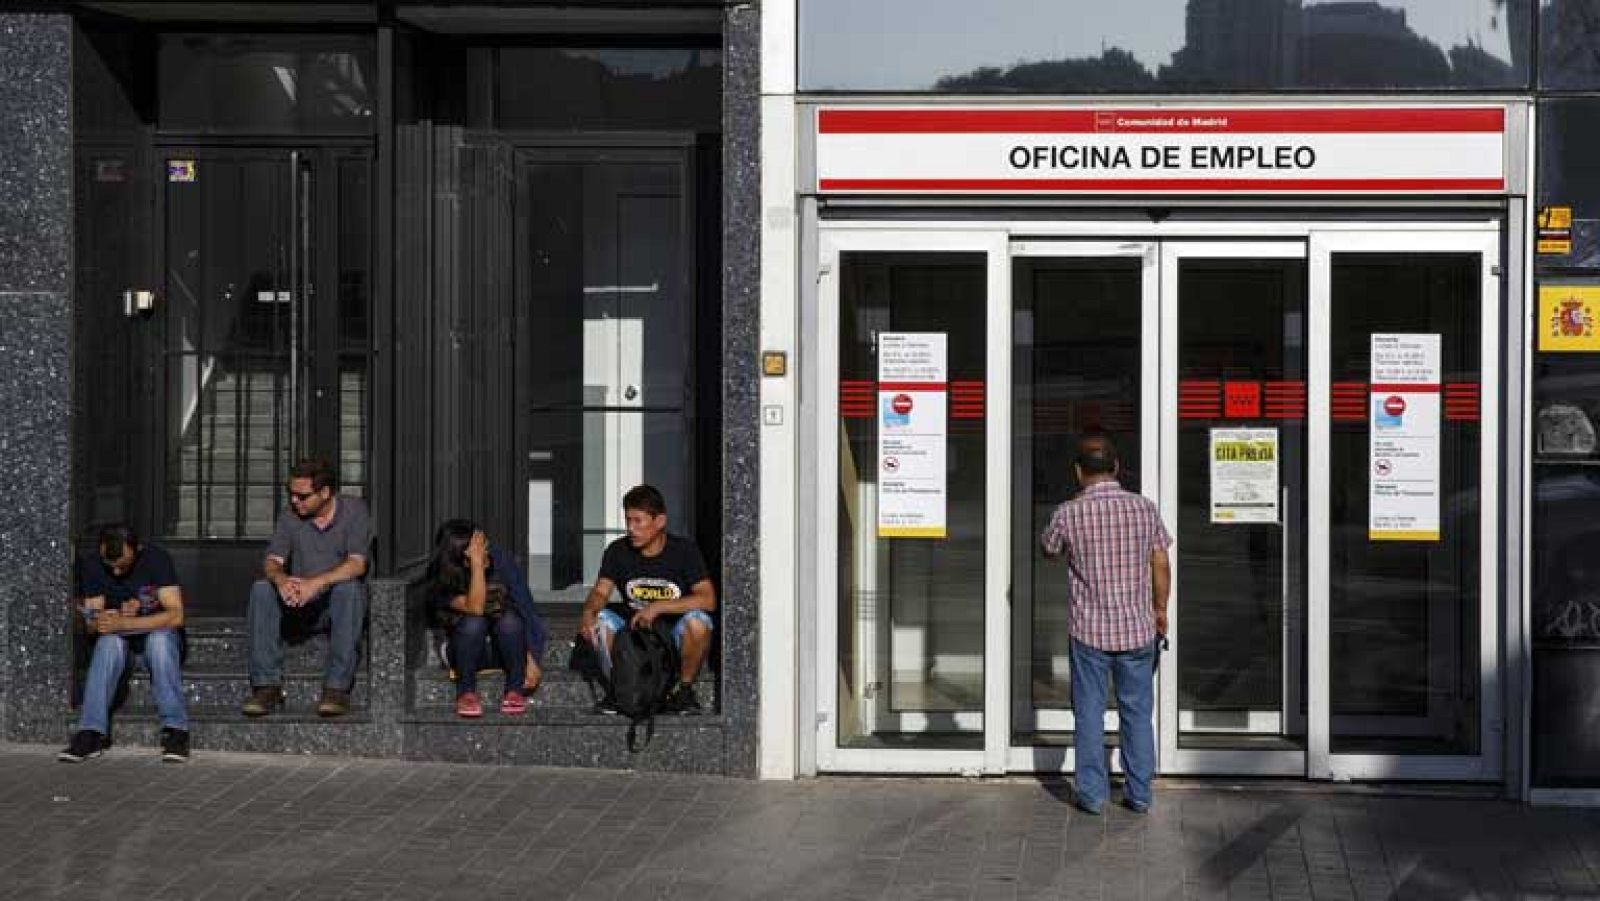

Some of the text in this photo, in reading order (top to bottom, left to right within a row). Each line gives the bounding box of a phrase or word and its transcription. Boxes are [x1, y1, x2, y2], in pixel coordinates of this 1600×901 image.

[1116, 117, 1228, 126] Comunidad de Madrid
[1009, 145, 1316, 169] OFICINA DE EMPLEO
